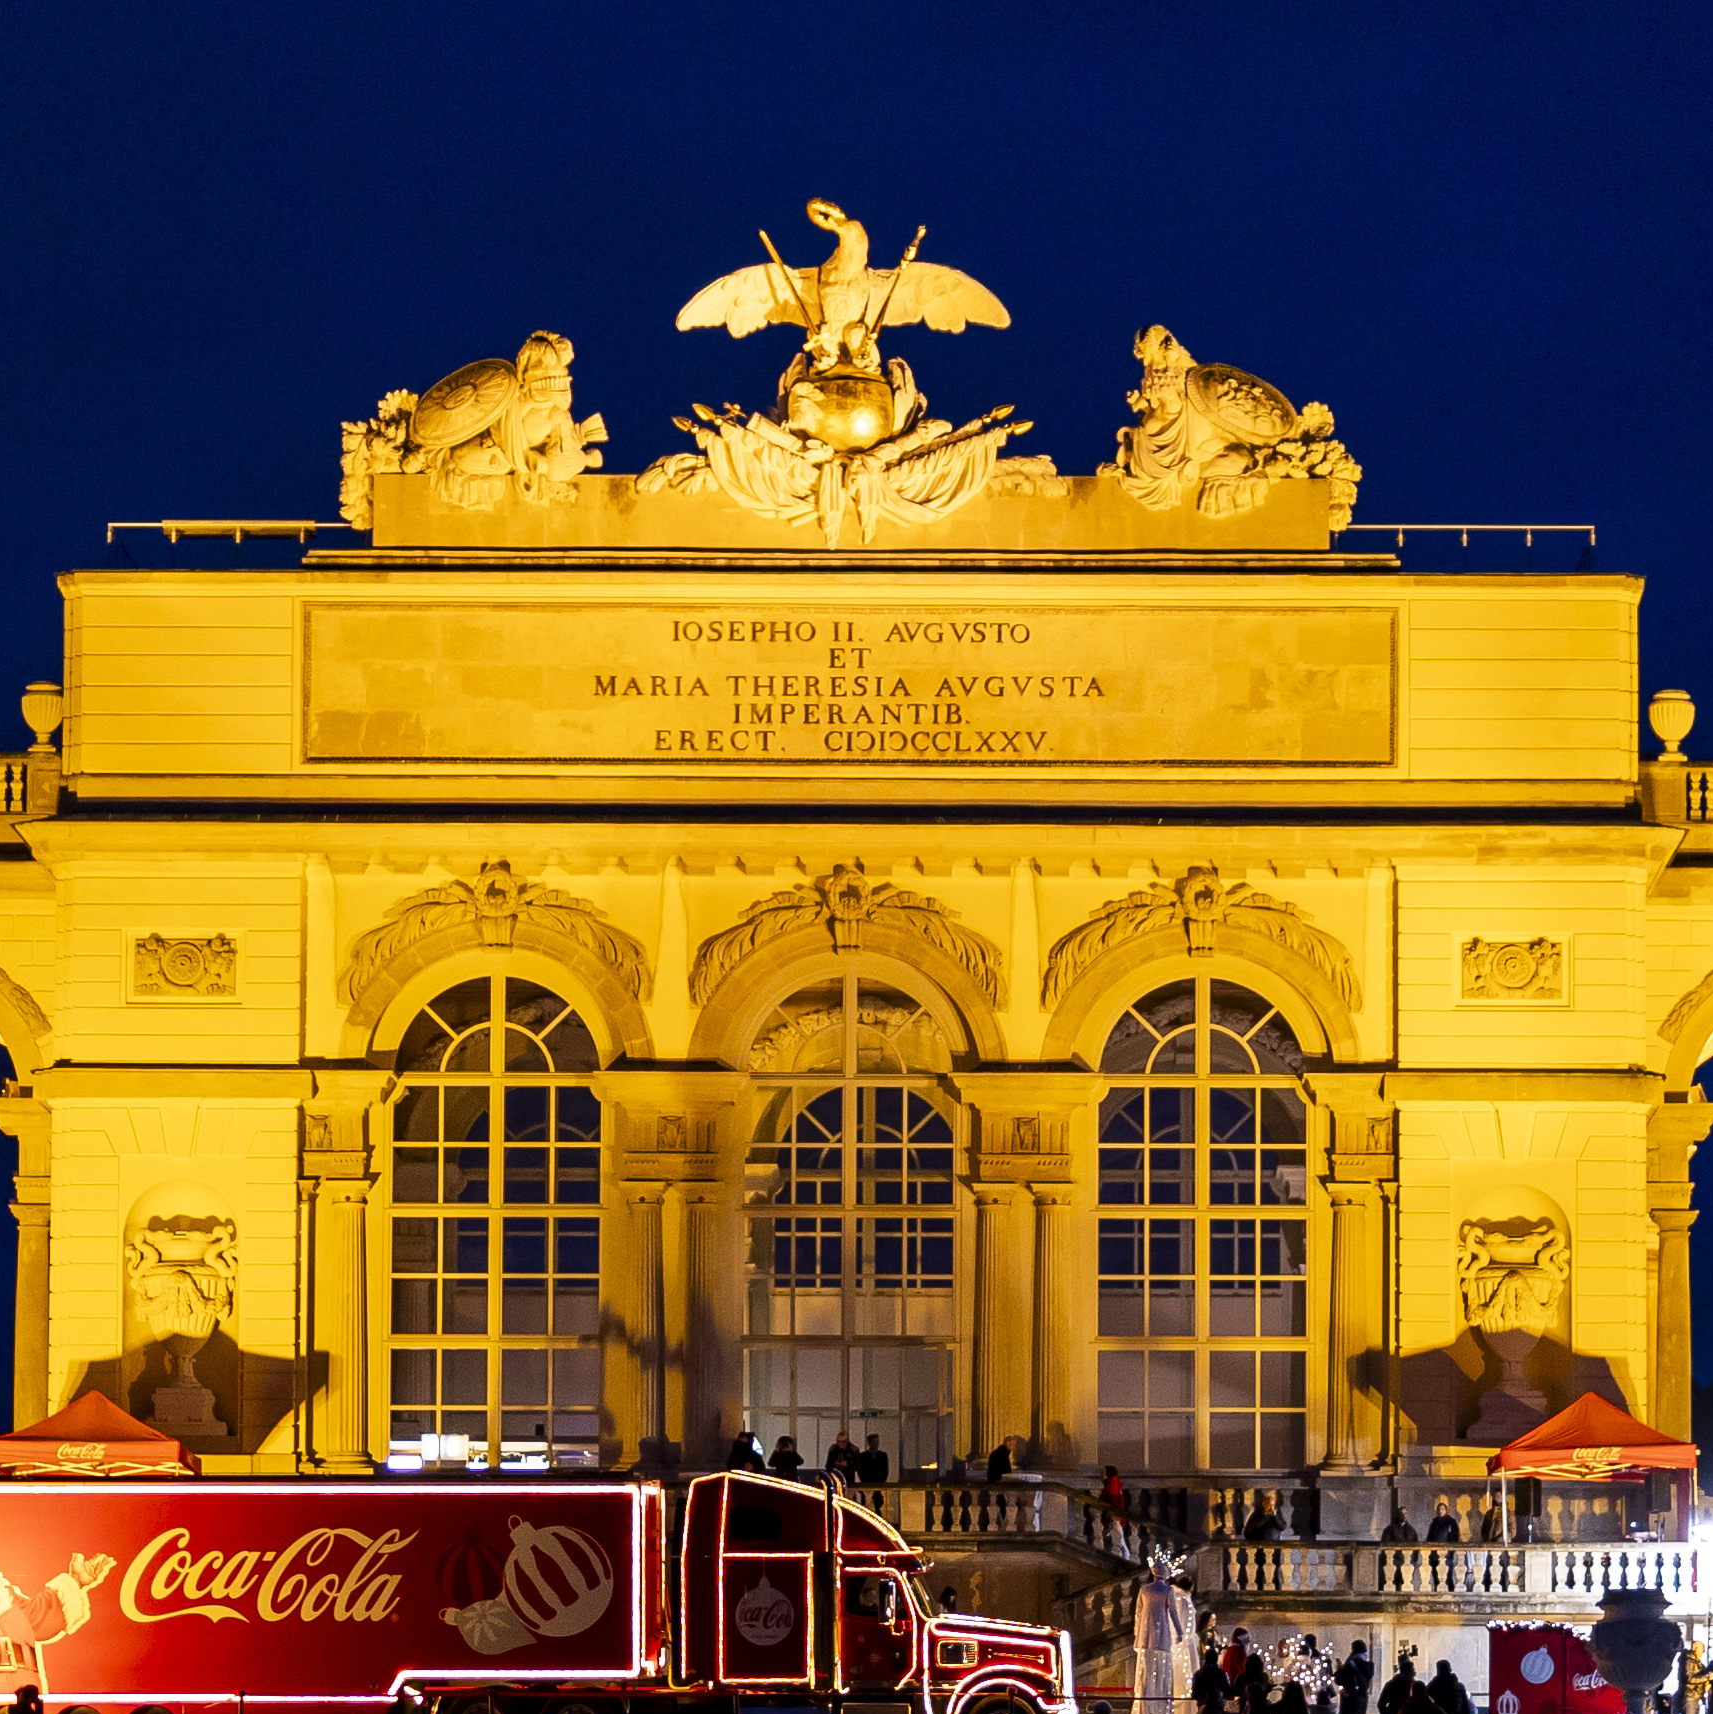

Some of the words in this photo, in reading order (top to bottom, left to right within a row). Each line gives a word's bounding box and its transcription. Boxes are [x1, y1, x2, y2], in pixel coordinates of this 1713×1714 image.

[672, 620, 816, 642] IOSEPHO
[832, 621, 864, 642] II.
[885, 621, 1031, 644] AVGVSTO
[829, 648, 871, 669] ET
[592, 675, 710, 697] MARIA
[726, 675, 912, 698] THERESIA
[934, 675, 1106, 698] AVGVSTA
[733, 702, 971, 726] IMPERANTIB.
[654, 730, 786, 752] ERECT.
[119, 1527, 420, 1624] Coca-Cola
